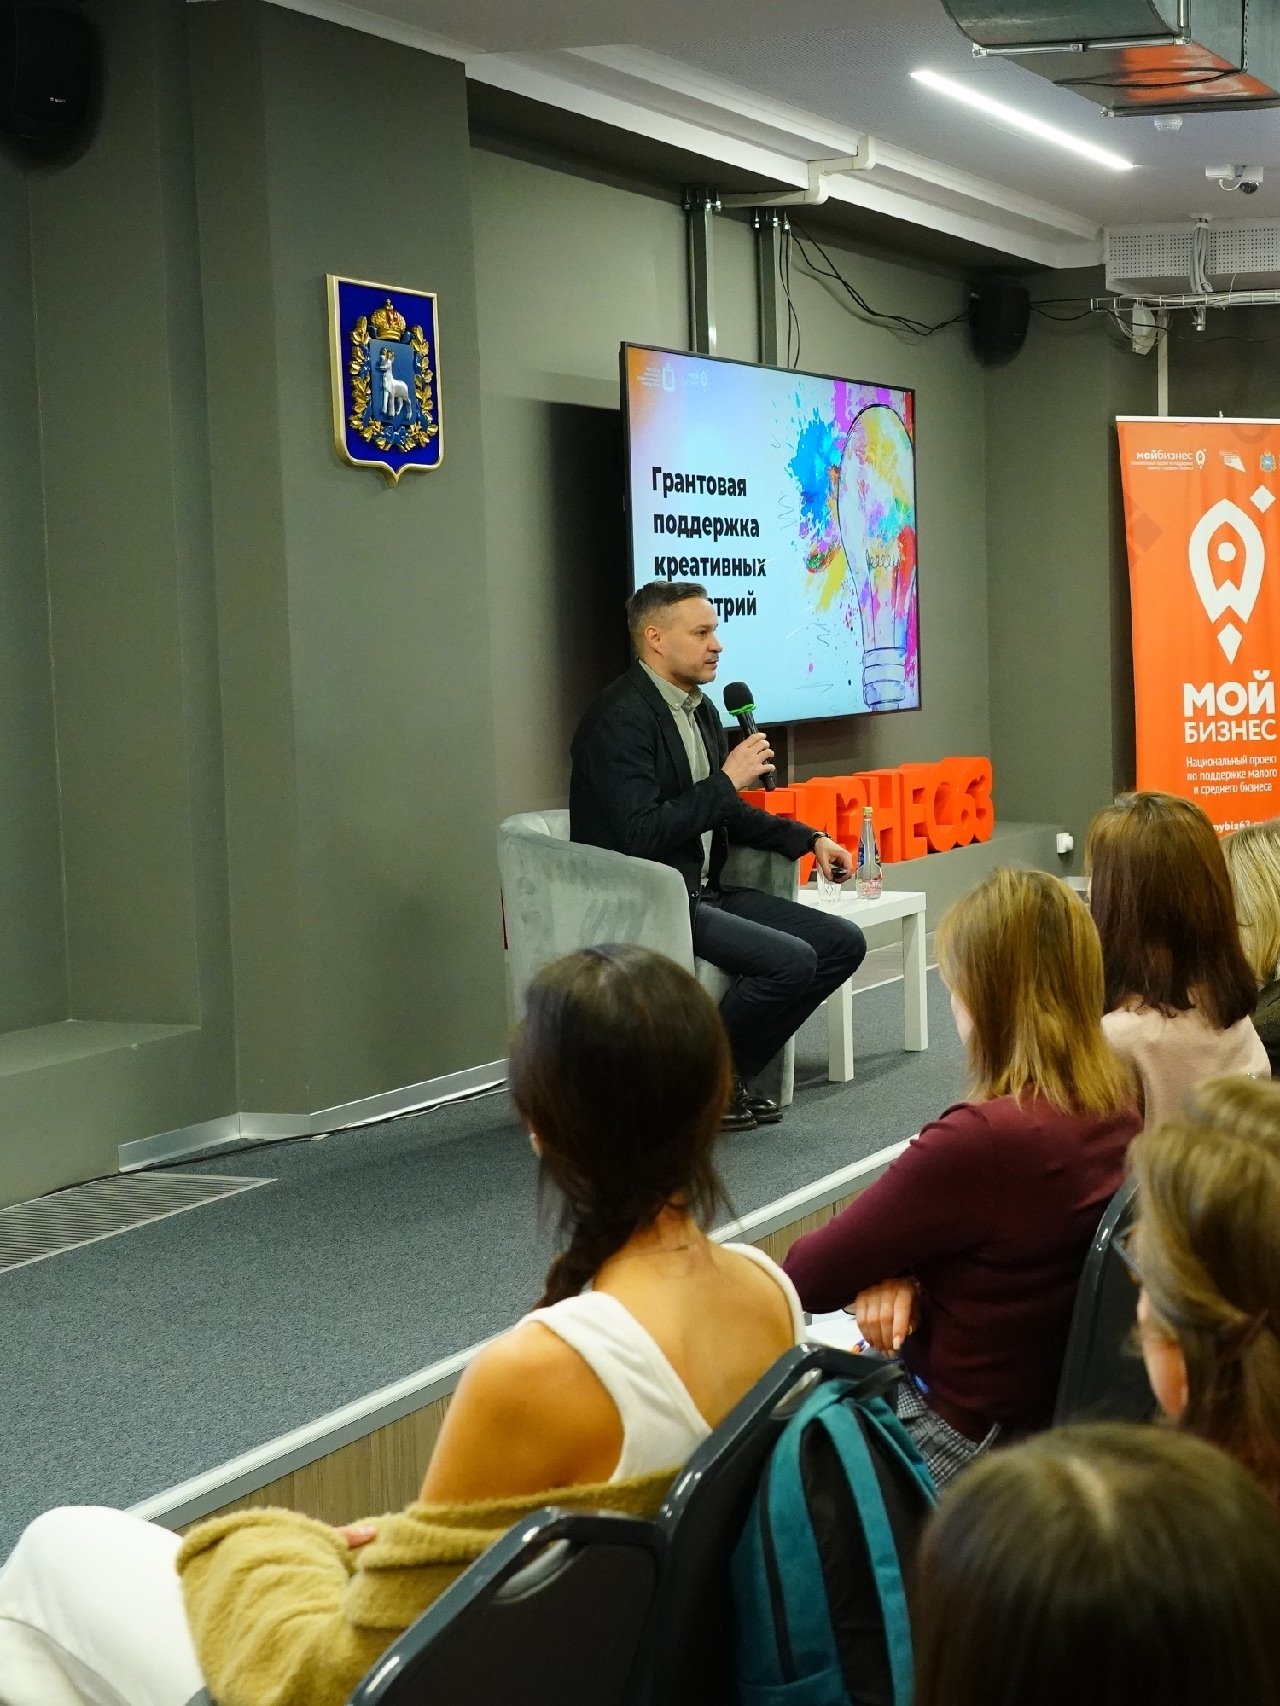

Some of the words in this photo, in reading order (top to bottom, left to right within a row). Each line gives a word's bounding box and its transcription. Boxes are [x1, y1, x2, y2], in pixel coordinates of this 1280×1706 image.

[652, 466, 747, 498] Грантовая
[653, 513, 760, 542] поддержка
[654, 556, 767, 582] креативных
[1183, 669, 1276, 717] МОЙ
[1184, 718, 1278, 744] БИЗНЕС
[1185, 755, 1248, 769] Национальный
[1249, 755, 1278, 767] проект
[1187, 773, 1198, 781] по
[1200, 770, 1247, 782] поддержке
[1248, 768, 1278, 778] малого
[1193, 786, 1199, 795] и
[1200, 785, 1238, 797] среднего
[1240, 782, 1273, 793] бизнеса
